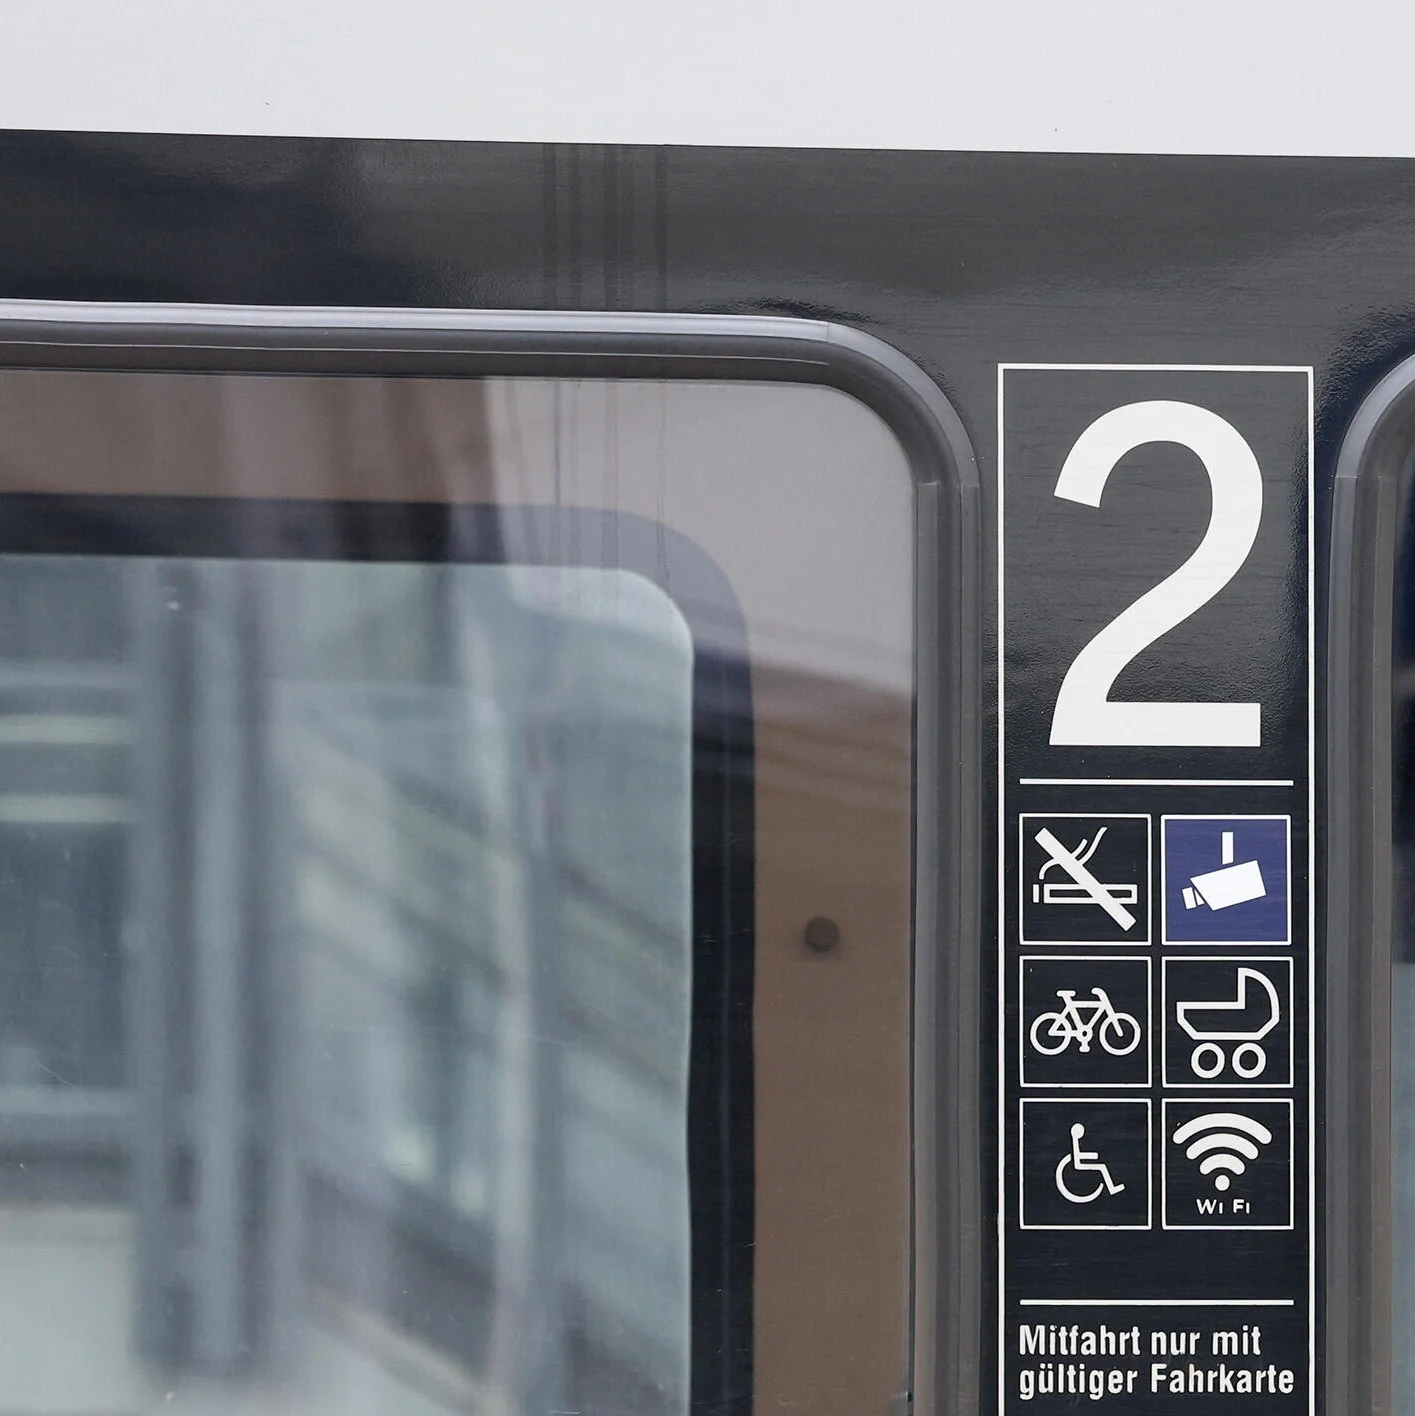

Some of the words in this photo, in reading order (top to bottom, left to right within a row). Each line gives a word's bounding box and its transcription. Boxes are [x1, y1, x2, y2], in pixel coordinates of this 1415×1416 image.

[1048, 400, 1262, 746] 2
[1019, 1325, 1141, 1355] Mitfahrt
[1151, 1331, 1200, 1355] nur
[1212, 1325, 1261, 1355] mit
[1019, 1363, 1138, 1400] gültiger
[1151, 1363, 1294, 1393] Fahrkarte
